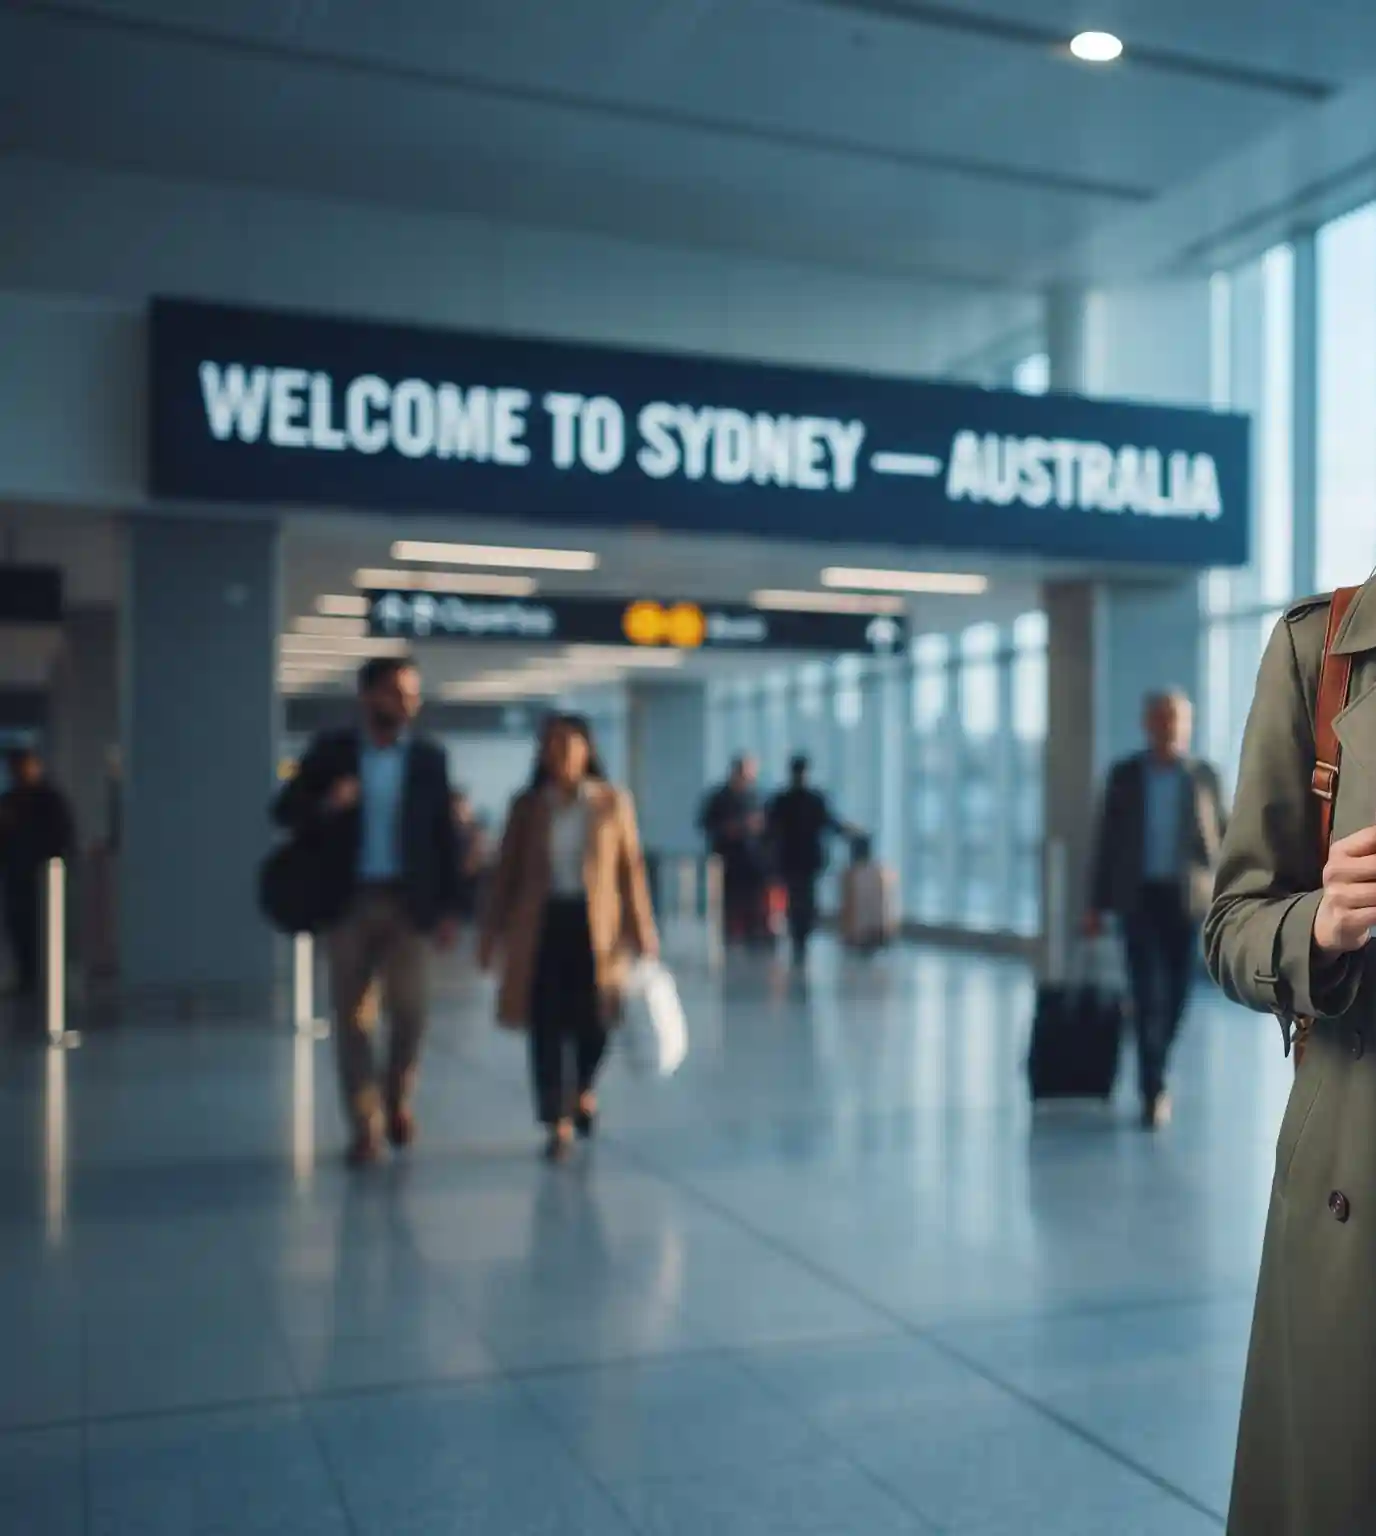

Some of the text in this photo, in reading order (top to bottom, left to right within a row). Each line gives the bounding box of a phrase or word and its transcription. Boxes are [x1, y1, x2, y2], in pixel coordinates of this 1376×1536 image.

[201, 361, 531, 466] WELCOME
[542, 391, 626, 474] TO
[636, 401, 866, 492] SYDNEY
[945, 430, 1224, 522] AUSTRALIA
